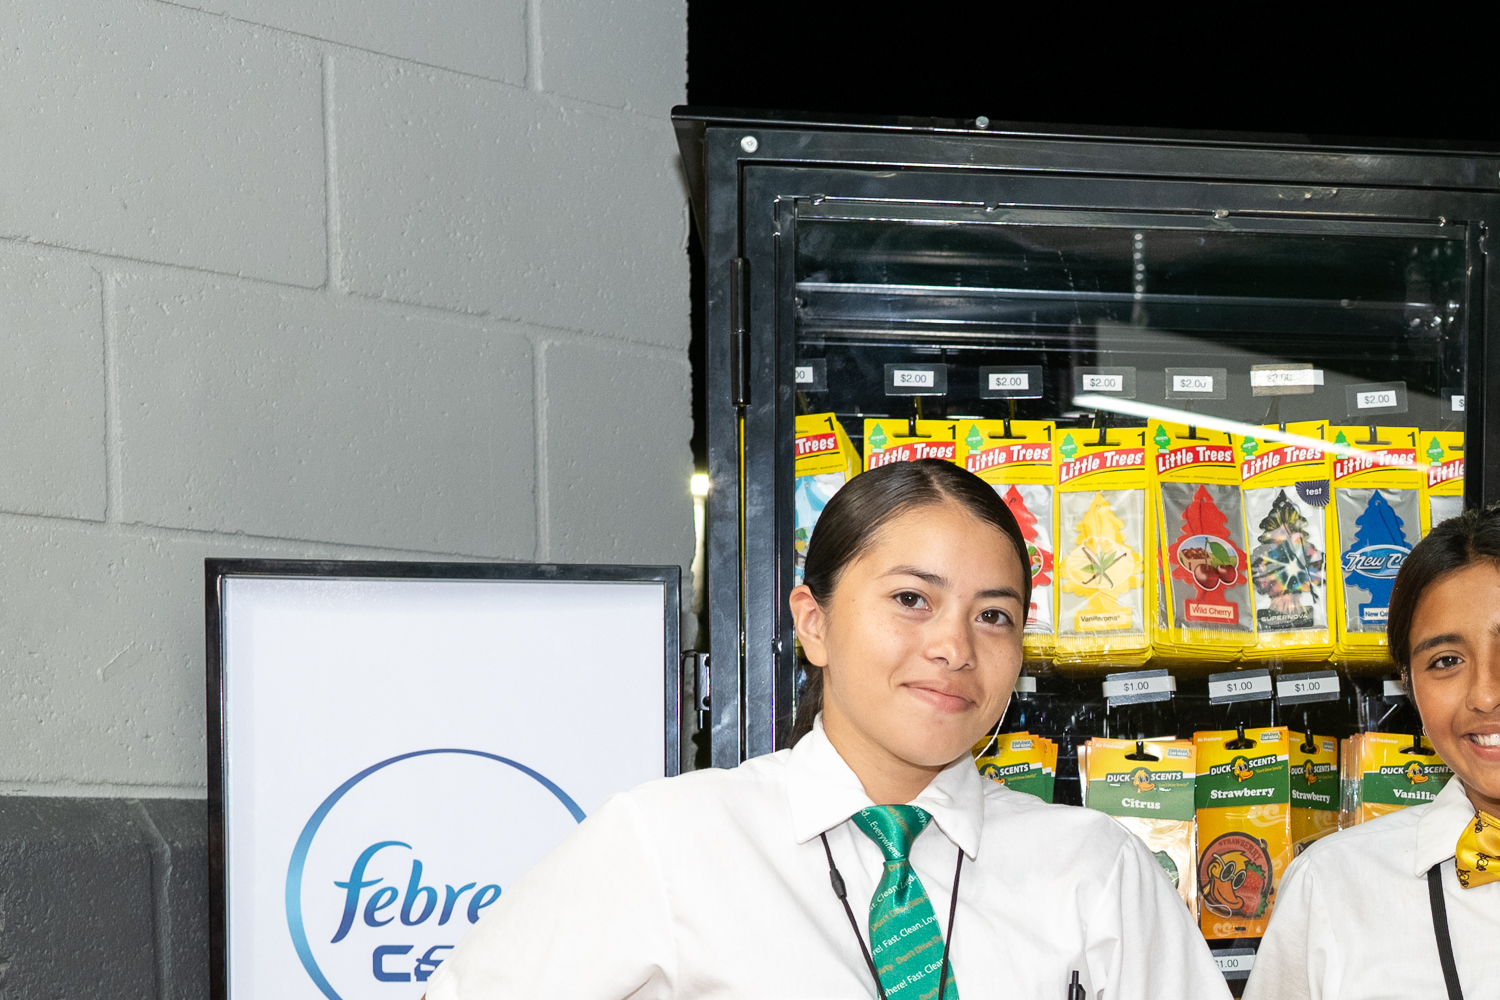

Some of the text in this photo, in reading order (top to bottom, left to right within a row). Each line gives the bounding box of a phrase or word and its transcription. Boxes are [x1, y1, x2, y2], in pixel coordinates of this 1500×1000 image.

[900, 374, 927, 384] $2.00
[995, 376, 1022, 387] $2.00
[1089, 377, 1116, 388] $2.00
[1364, 394, 1390, 405] $2.00
[795, 436, 835, 454] Trees
[870, 443, 955, 469] Little Trees
[967, 446, 1051, 474] Little Trees
[1158, 446, 1233, 473] Little Trees
[1242, 445, 1322, 480] Little Trees
[1061, 451, 1144, 482] Little Trees
[1335, 450, 1415, 479] Little Trees
[1305, 486, 1323, 496] test
[1346, 552, 1386, 571] New
[1191, 605, 1232, 618] Wild Cherry
[1123, 681, 1149, 691] $1.00
[1227, 682, 1252, 692] $1.00
[1295, 682, 1320, 692] $1.00
[1000, 764, 1029, 776] SCENTS
[1211, 756, 1276, 775] DUCK SCENTS
[1291, 767, 1304, 775] DUCK
[1314, 765, 1331, 773] SCENTS
[1381, 767, 1404, 775] DUCK
[1107, 772, 1181, 782] DUCK SCENTS
[1210, 787, 1275, 799] Strawberry
[1292, 789, 1330, 804] Strawberry
[1121, 797, 1161, 810] Citrus
[882, 922, 924, 948] Fast. Clean.
[907, 971, 926, 984] Fast.
